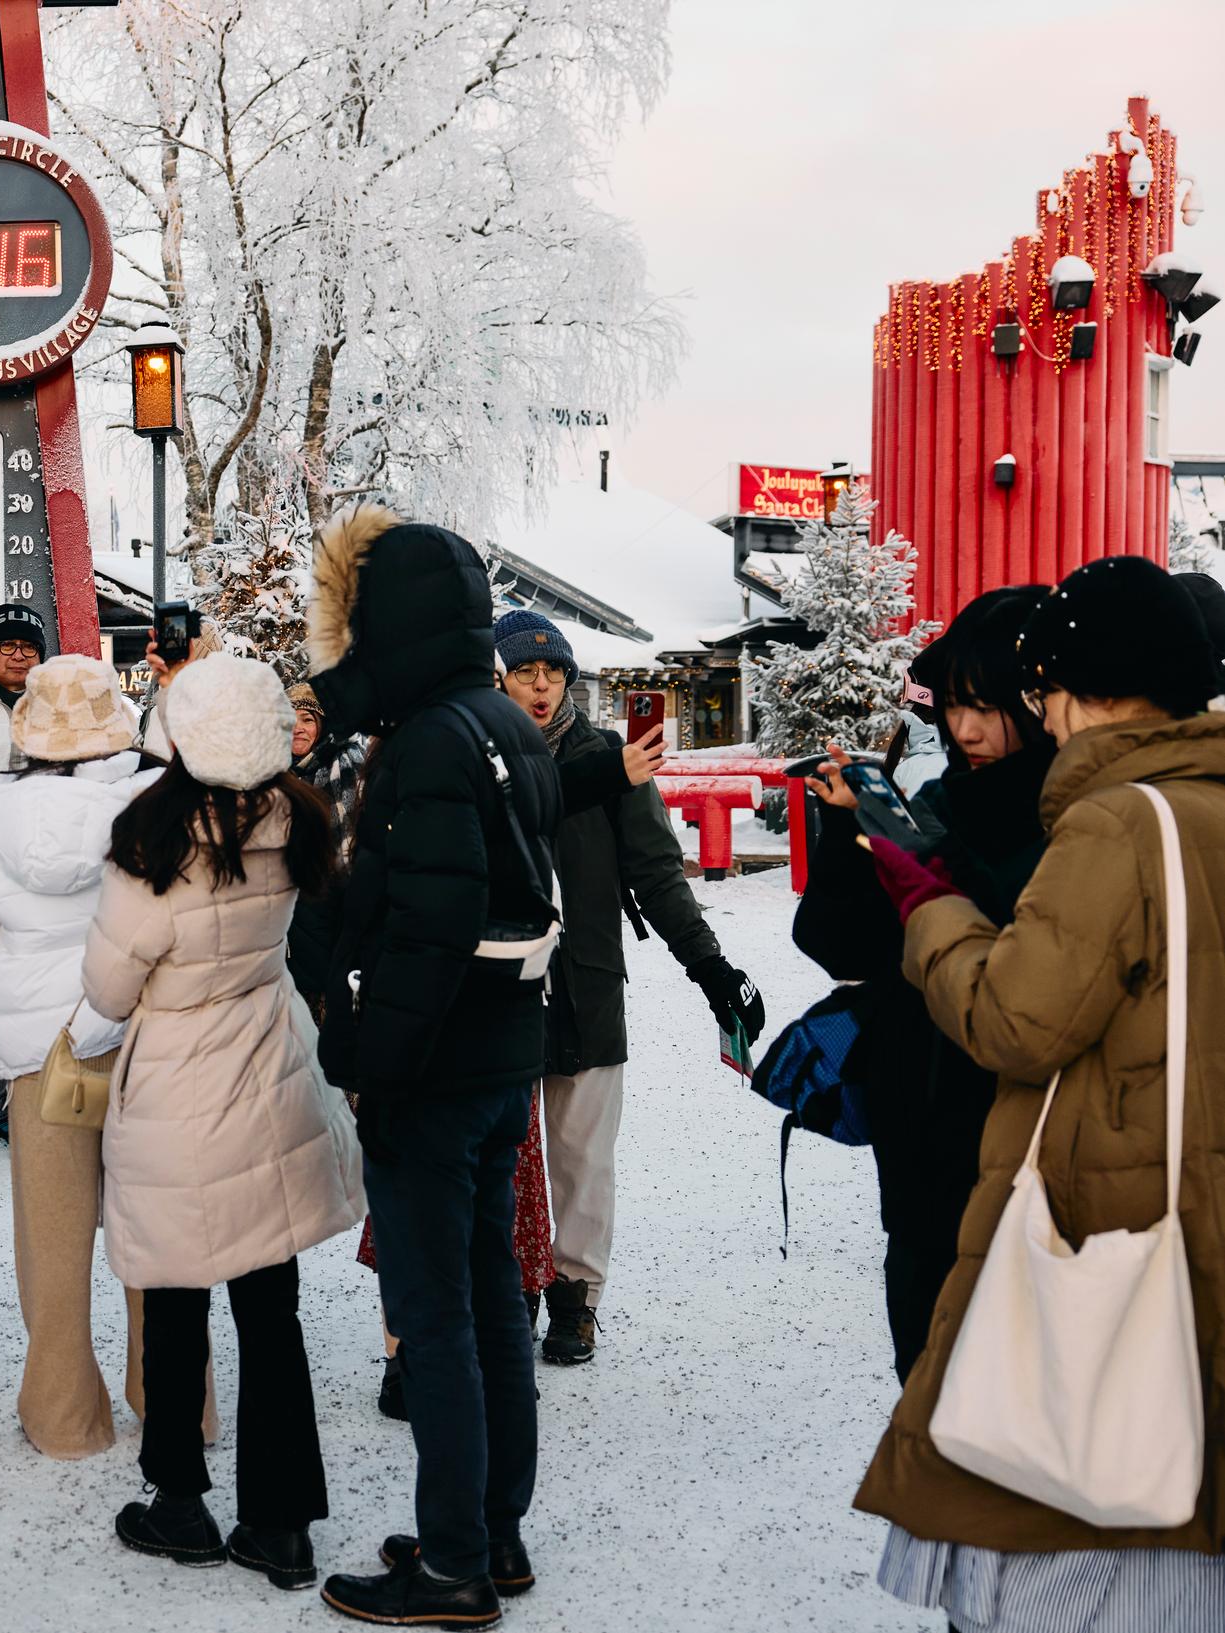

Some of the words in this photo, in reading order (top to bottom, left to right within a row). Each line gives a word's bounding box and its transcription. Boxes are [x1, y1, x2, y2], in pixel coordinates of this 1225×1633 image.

[26, 304, 99, 373] VILLAGE
[7, 448, 33, 472] 40
[7, 493, 34, 514] 30
[754, 493, 801, 515] Santa
[8, 534, 34, 555] 20
[9, 579, 34, 600] 10
